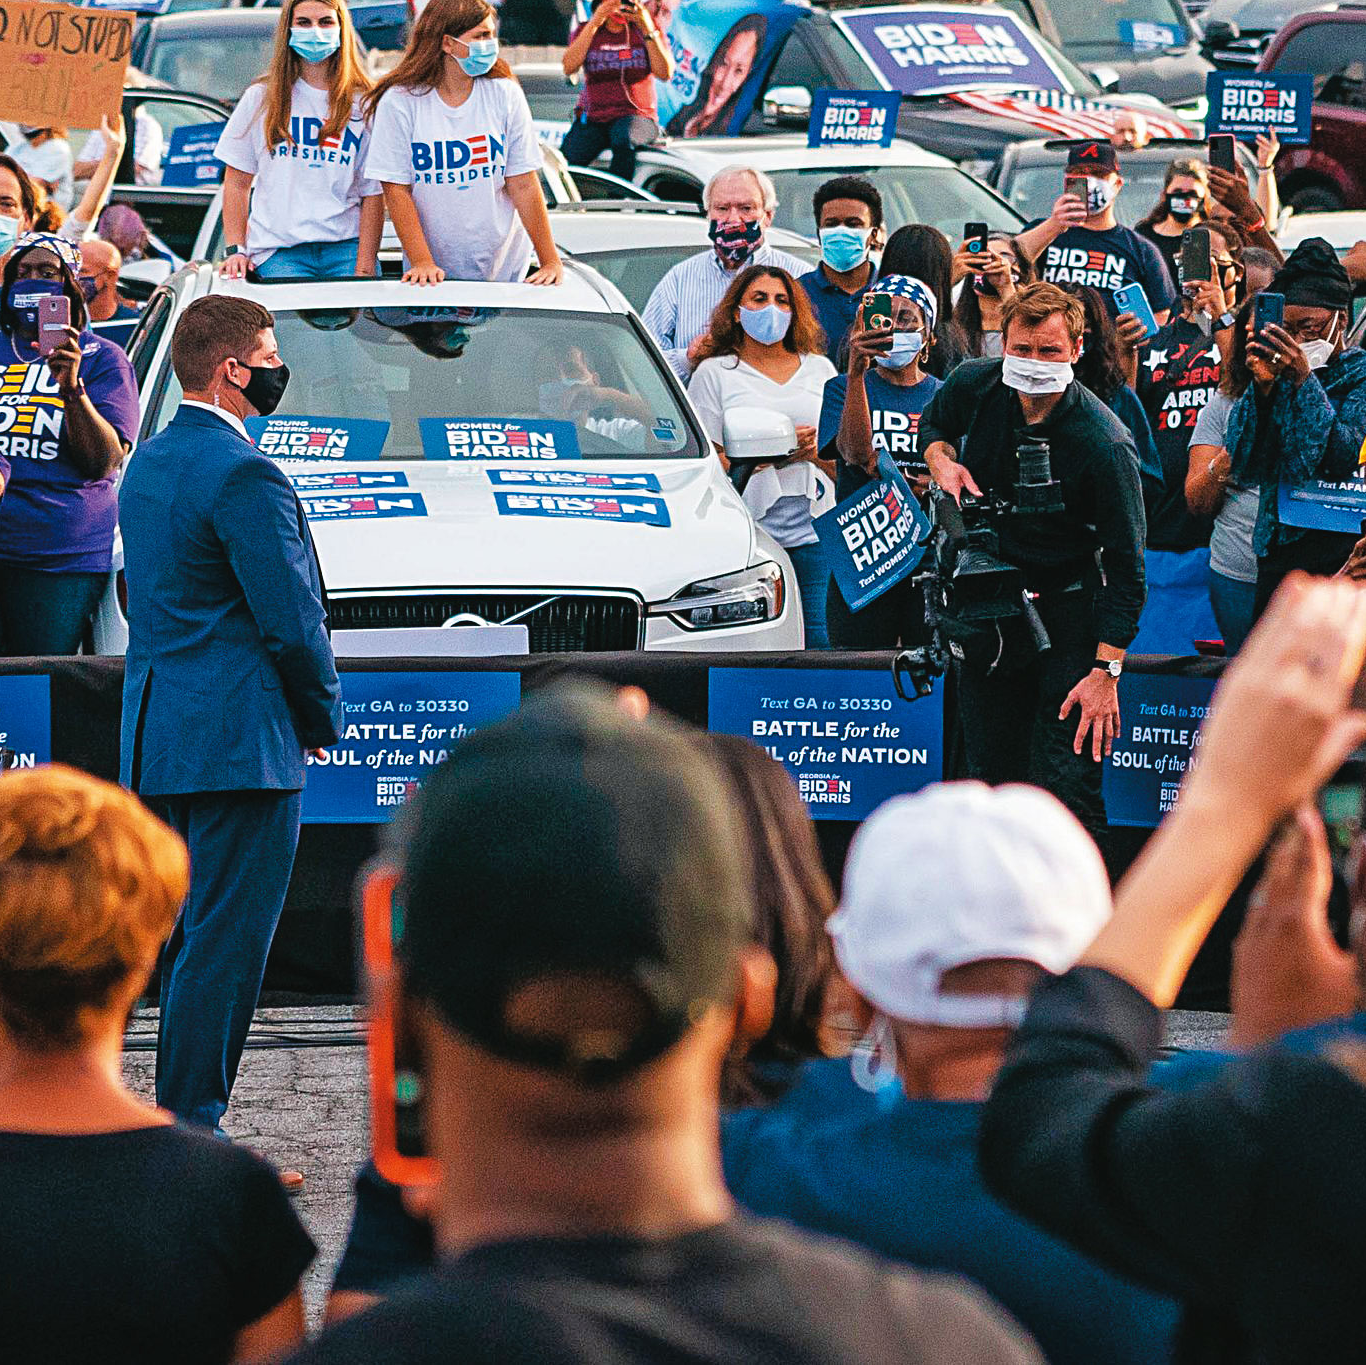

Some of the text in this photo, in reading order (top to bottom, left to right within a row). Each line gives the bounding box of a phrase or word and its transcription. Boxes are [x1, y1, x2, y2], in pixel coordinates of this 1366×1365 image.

[16, 8, 65, 51] NOT
[61, 14, 133, 62] STUPID
[874, 23, 1016, 48] BIDEN
[890, 45, 1030, 68] HARRIS
[1223, 79, 1263, 88] WOMEN
[1222, 88, 1297, 108] BIDEN
[823, 107, 886, 126] BIDEN
[1221, 107, 1296, 123] HARRIS
[821, 126, 884, 141] HARRIS
[410, 133, 506, 173] BIDEN
[1046, 246, 1127, 275] BIDEN
[1042, 267, 1124, 290] HARRIS
[0, 395, 29, 406] FOR
[503, 423, 522, 432] for
[1158, 409, 1197, 431] 202
[260, 432, 350, 447] BIDEN
[265, 426, 333, 434] AMERICANS
[446, 430, 555, 446] BIDEN
[258, 445, 346, 458] HARRIS
[449, 445, 558, 459] HARRIS
[499, 472, 648, 485] BIDEN
[1317, 480, 1337, 490] Text
[506, 498, 658, 515] BIDEN
[837, 490, 880, 526] WOMEN
[842, 480, 905, 552] BIDEN
[852, 502, 914, 573] HARRIS
[858, 546, 909, 588] Text WOMEN
[370, 700, 469, 713] GA to 30330
[760, 697, 892, 711] Text GA to 30330
[1139, 704, 1188, 718] Text GA to
[341, 724, 447, 743] ATTLE for
[752, 720, 900, 741] BATTLE for the
[1132, 726, 1189, 746] BATTLE
[366, 749, 387, 769] of
[387, 749, 414, 766] the
[788, 746, 810, 765] of
[809, 746, 836, 763] the
[841, 747, 927, 764] NATION
[1112, 751, 1186, 774] SOUL of the
[798, 779, 851, 793] BIDEN
[798, 792, 851, 804] HARRIS
